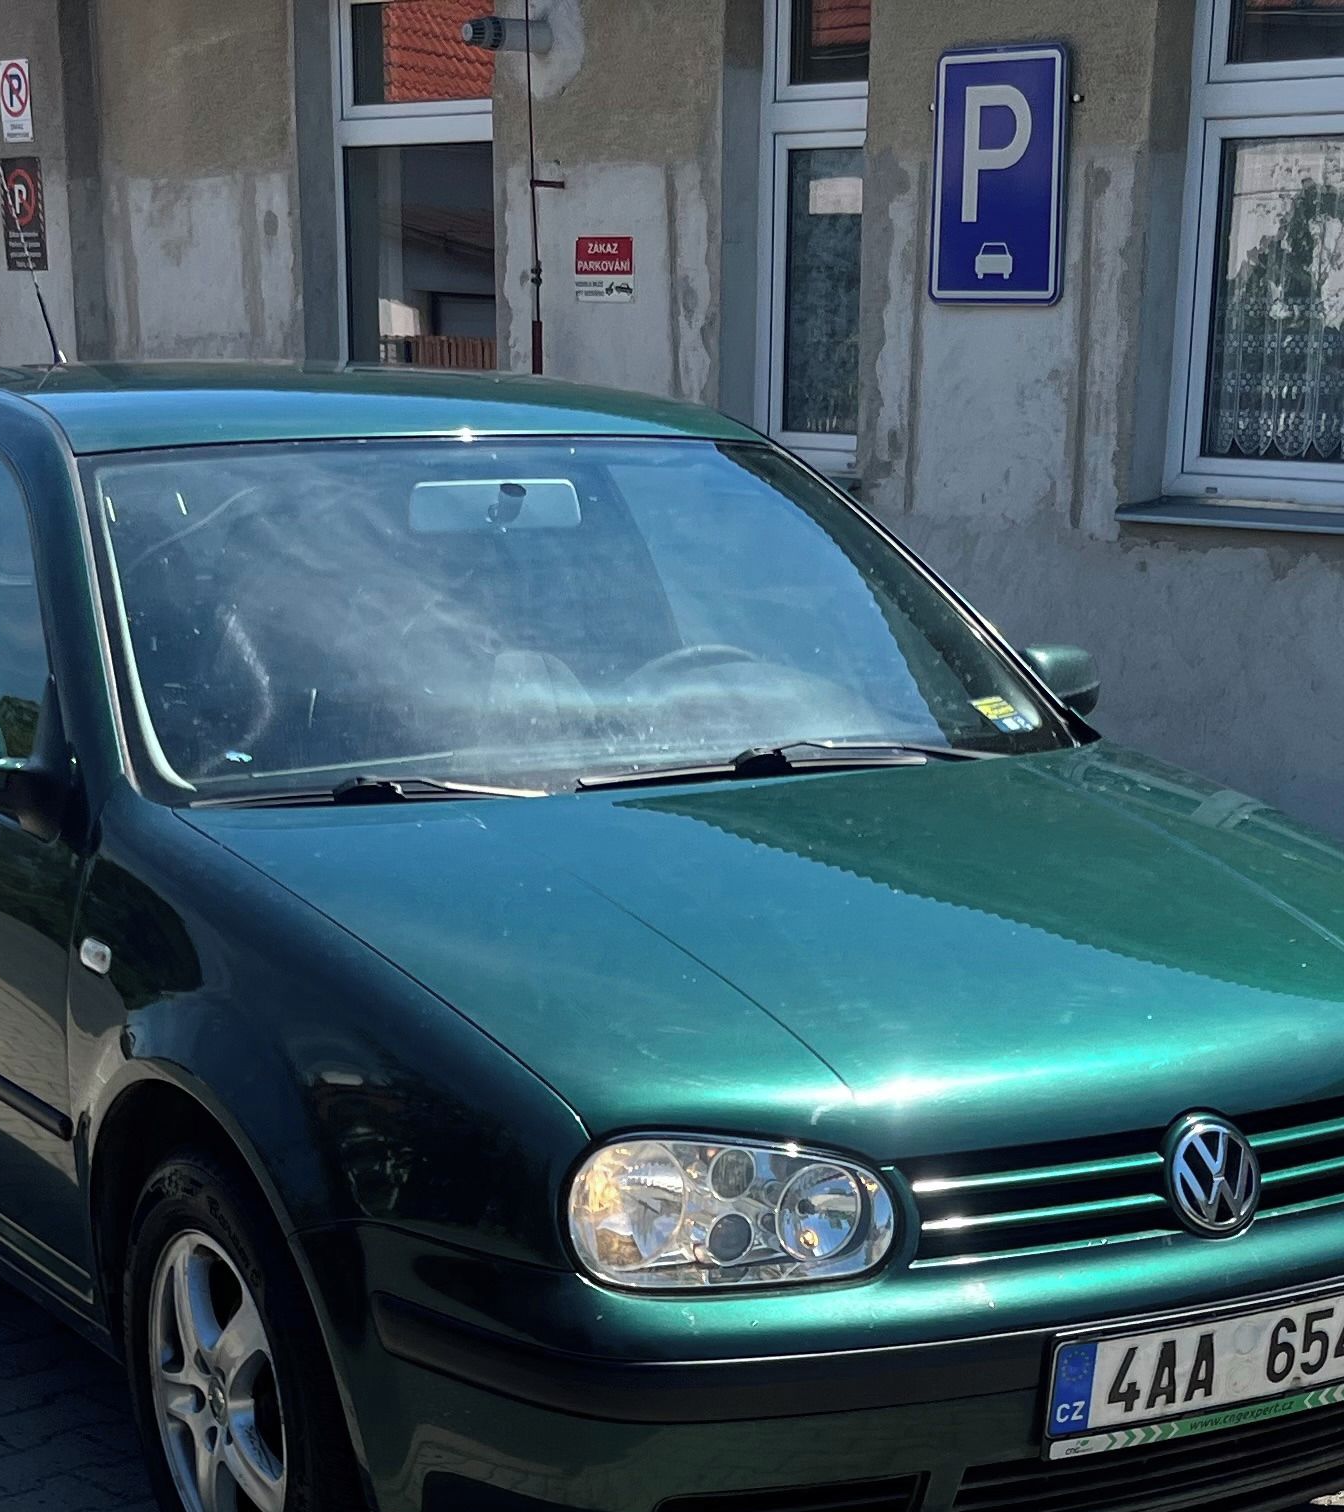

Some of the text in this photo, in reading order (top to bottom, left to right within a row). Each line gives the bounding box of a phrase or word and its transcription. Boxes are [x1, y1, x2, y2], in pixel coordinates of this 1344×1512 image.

[961, 84, 1032, 223] P
[587, 241, 619, 254] ZÁKAZ
[577, 258, 631, 272] PARKOVÁNÍ
[1107, 1333, 1215, 1413] 4AA
[1056, 1400, 1085, 1423] CZ
[1189, 1400, 1295, 1431] www.cngexpert.cz
